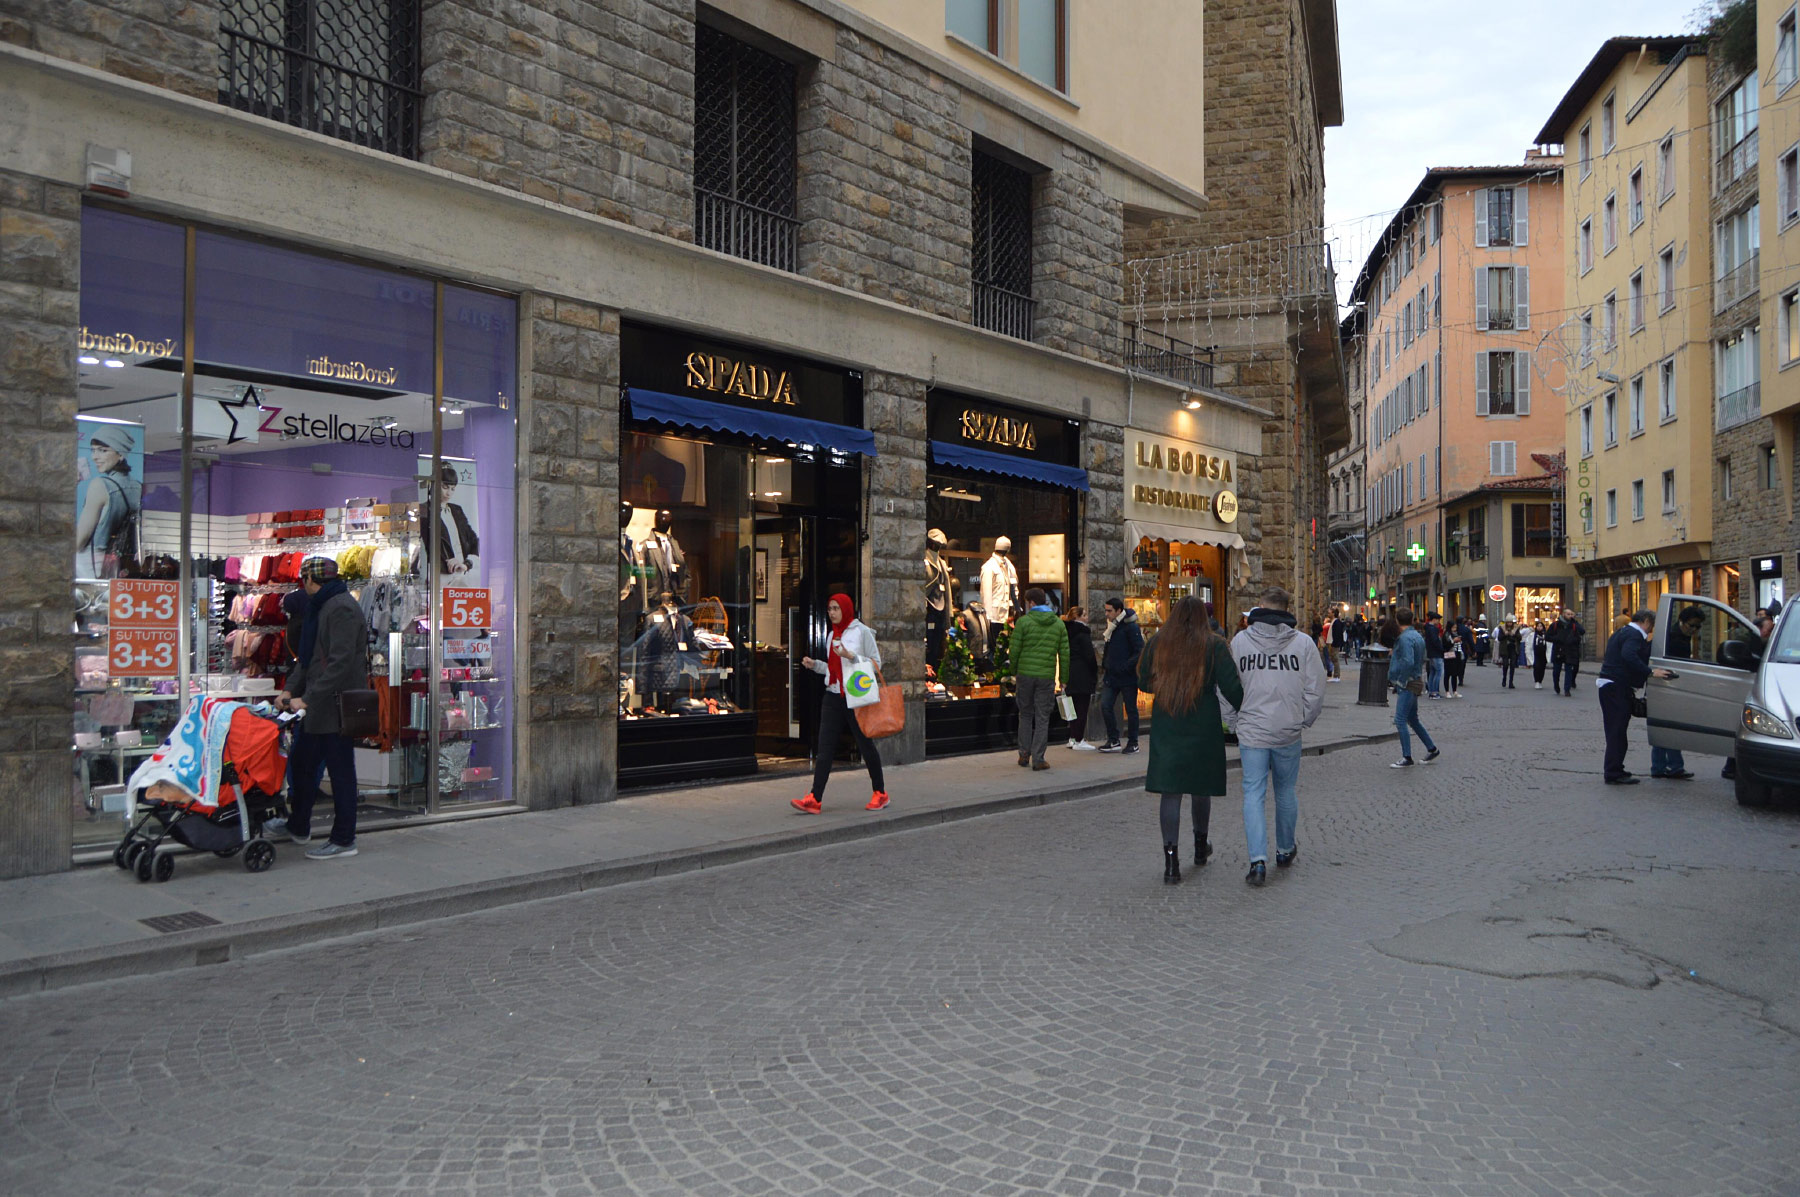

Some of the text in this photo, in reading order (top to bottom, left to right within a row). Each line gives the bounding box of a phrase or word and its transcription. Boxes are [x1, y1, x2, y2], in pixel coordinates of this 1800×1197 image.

[686, 352, 798, 405] SPADA
[283, 412, 415, 449] stellazeta
[962, 409, 1037, 450] SPADA
[1136, 441, 1233, 483] LA BORSA
[1134, 484, 1211, 512] RISTORANTE
[116, 582, 177, 593] SU TUTTO!
[448, 589, 487, 598] Borse da
[1518, 587, 1557, 604] Venchi
[451, 599, 484, 626] 5€
[116, 631, 176, 641] SU TUTTO!
[1240, 653, 1300, 673] OHUENO
